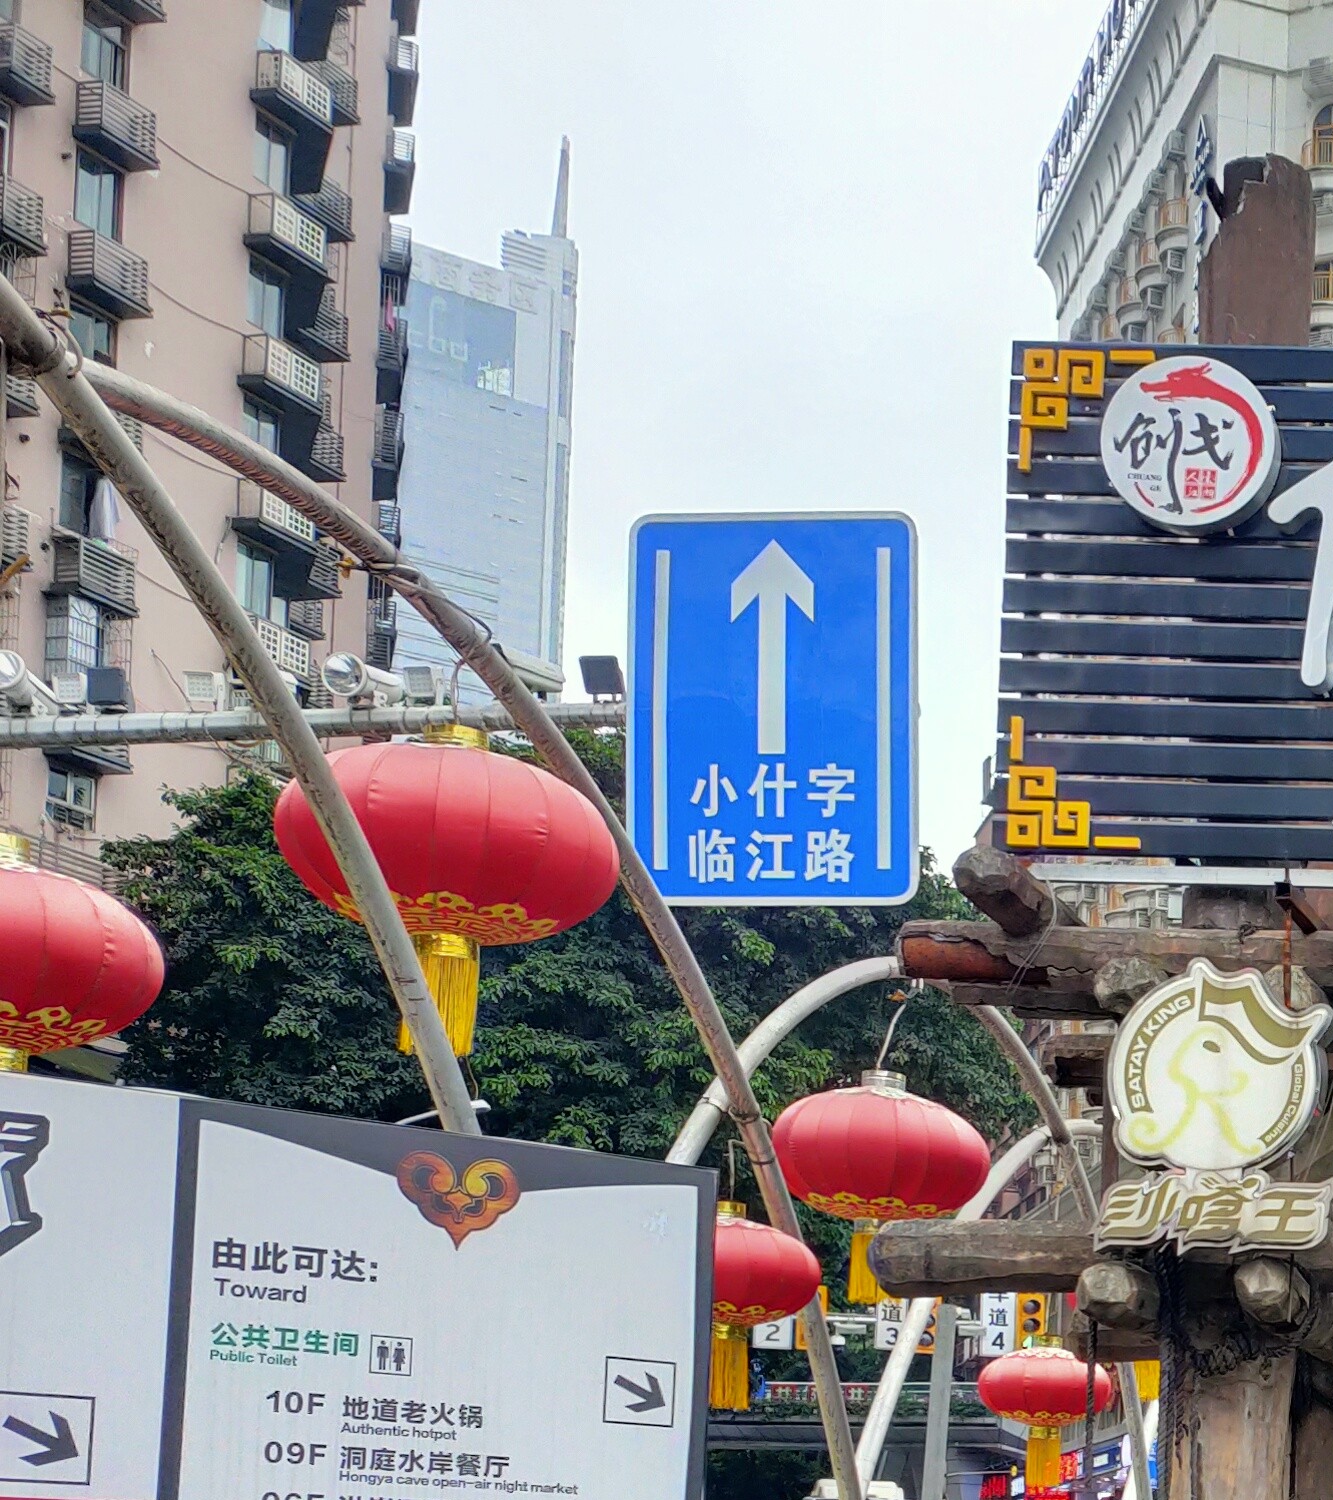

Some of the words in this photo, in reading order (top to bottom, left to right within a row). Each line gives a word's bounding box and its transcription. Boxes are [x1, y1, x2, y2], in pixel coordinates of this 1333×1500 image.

[690, 763, 855, 818] 小什字
[688, 828, 855, 883] 临江路
[1132, 1036, 1149, 1108] SATAY
[1145, 994, 1192, 1035] KING
[211, 1238, 378, 1283] 由此可达:
[214, 1277, 307, 1303] Toward
[209, 1349, 254, 1364] Public
[259, 1352, 297, 1367] Toilet
[211, 1322, 359, 1357] 公共卫生间
[265, 1390, 326, 1415] 10F
[342, 1395, 483, 1429] 地道老火锅
[340, 1422, 409, 1437] Authentic
[412, 1426, 457, 1441] hotpot
[264, 1441, 327, 1466] 09F
[340, 1446, 510, 1479] 洞庭水岸餐厅
[339, 1471, 393, 1486] Hongya
[396, 1475, 429, 1487] cave
[432, 1478, 492, 1491] open-air
[494, 1479, 528, 1494] night
[530, 1482, 578, 1495] market
